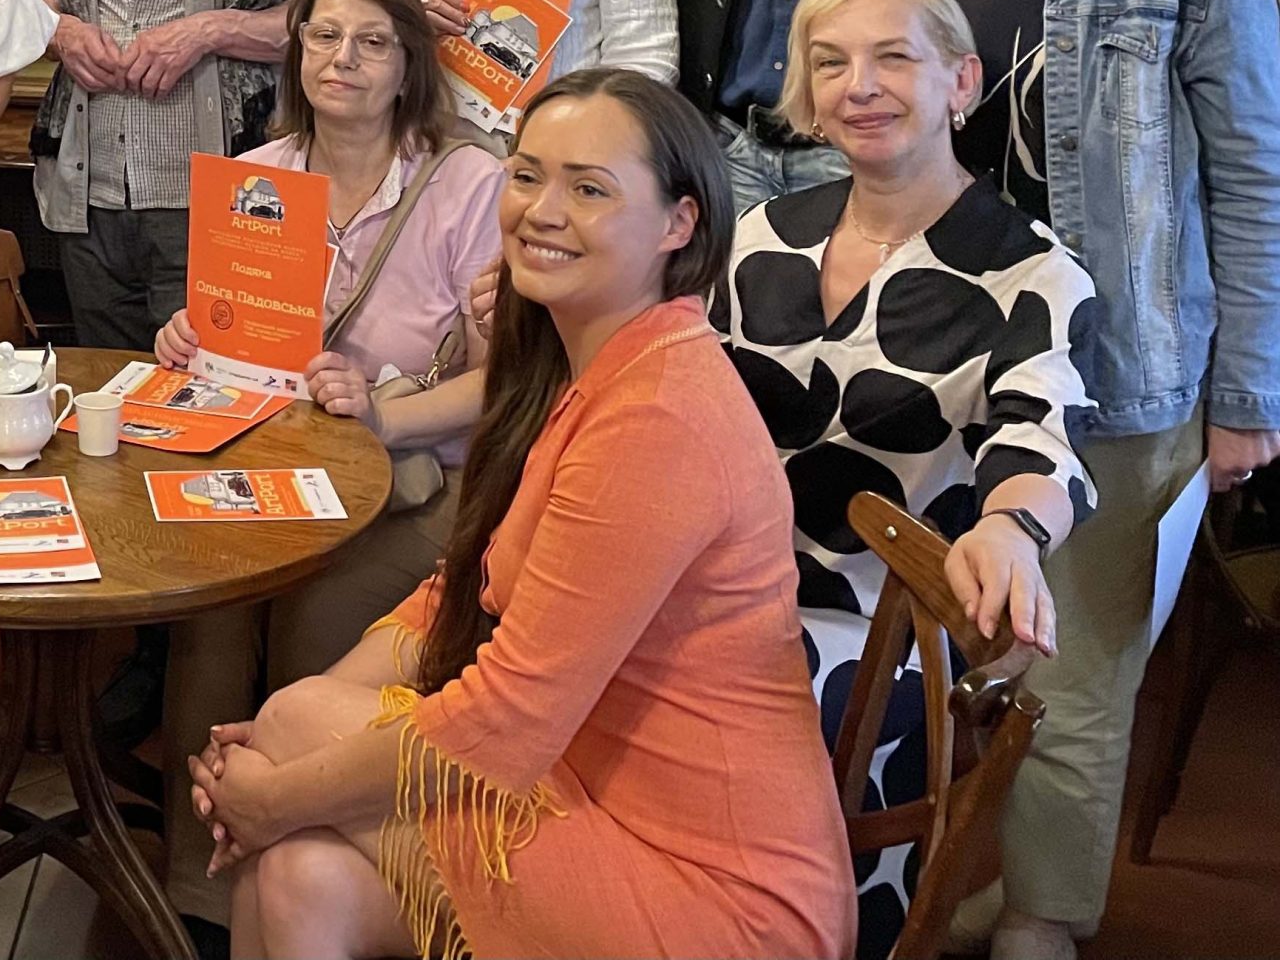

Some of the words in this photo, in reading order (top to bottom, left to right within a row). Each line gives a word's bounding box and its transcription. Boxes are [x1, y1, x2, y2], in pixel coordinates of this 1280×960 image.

[441, 36, 517, 92] ArtPort
[231, 216, 283, 237] ArtPort
[195, 280, 234, 301] Ольга
[237, 291, 317, 318] Падовська
[253, 473, 284, 515] ArtPort
